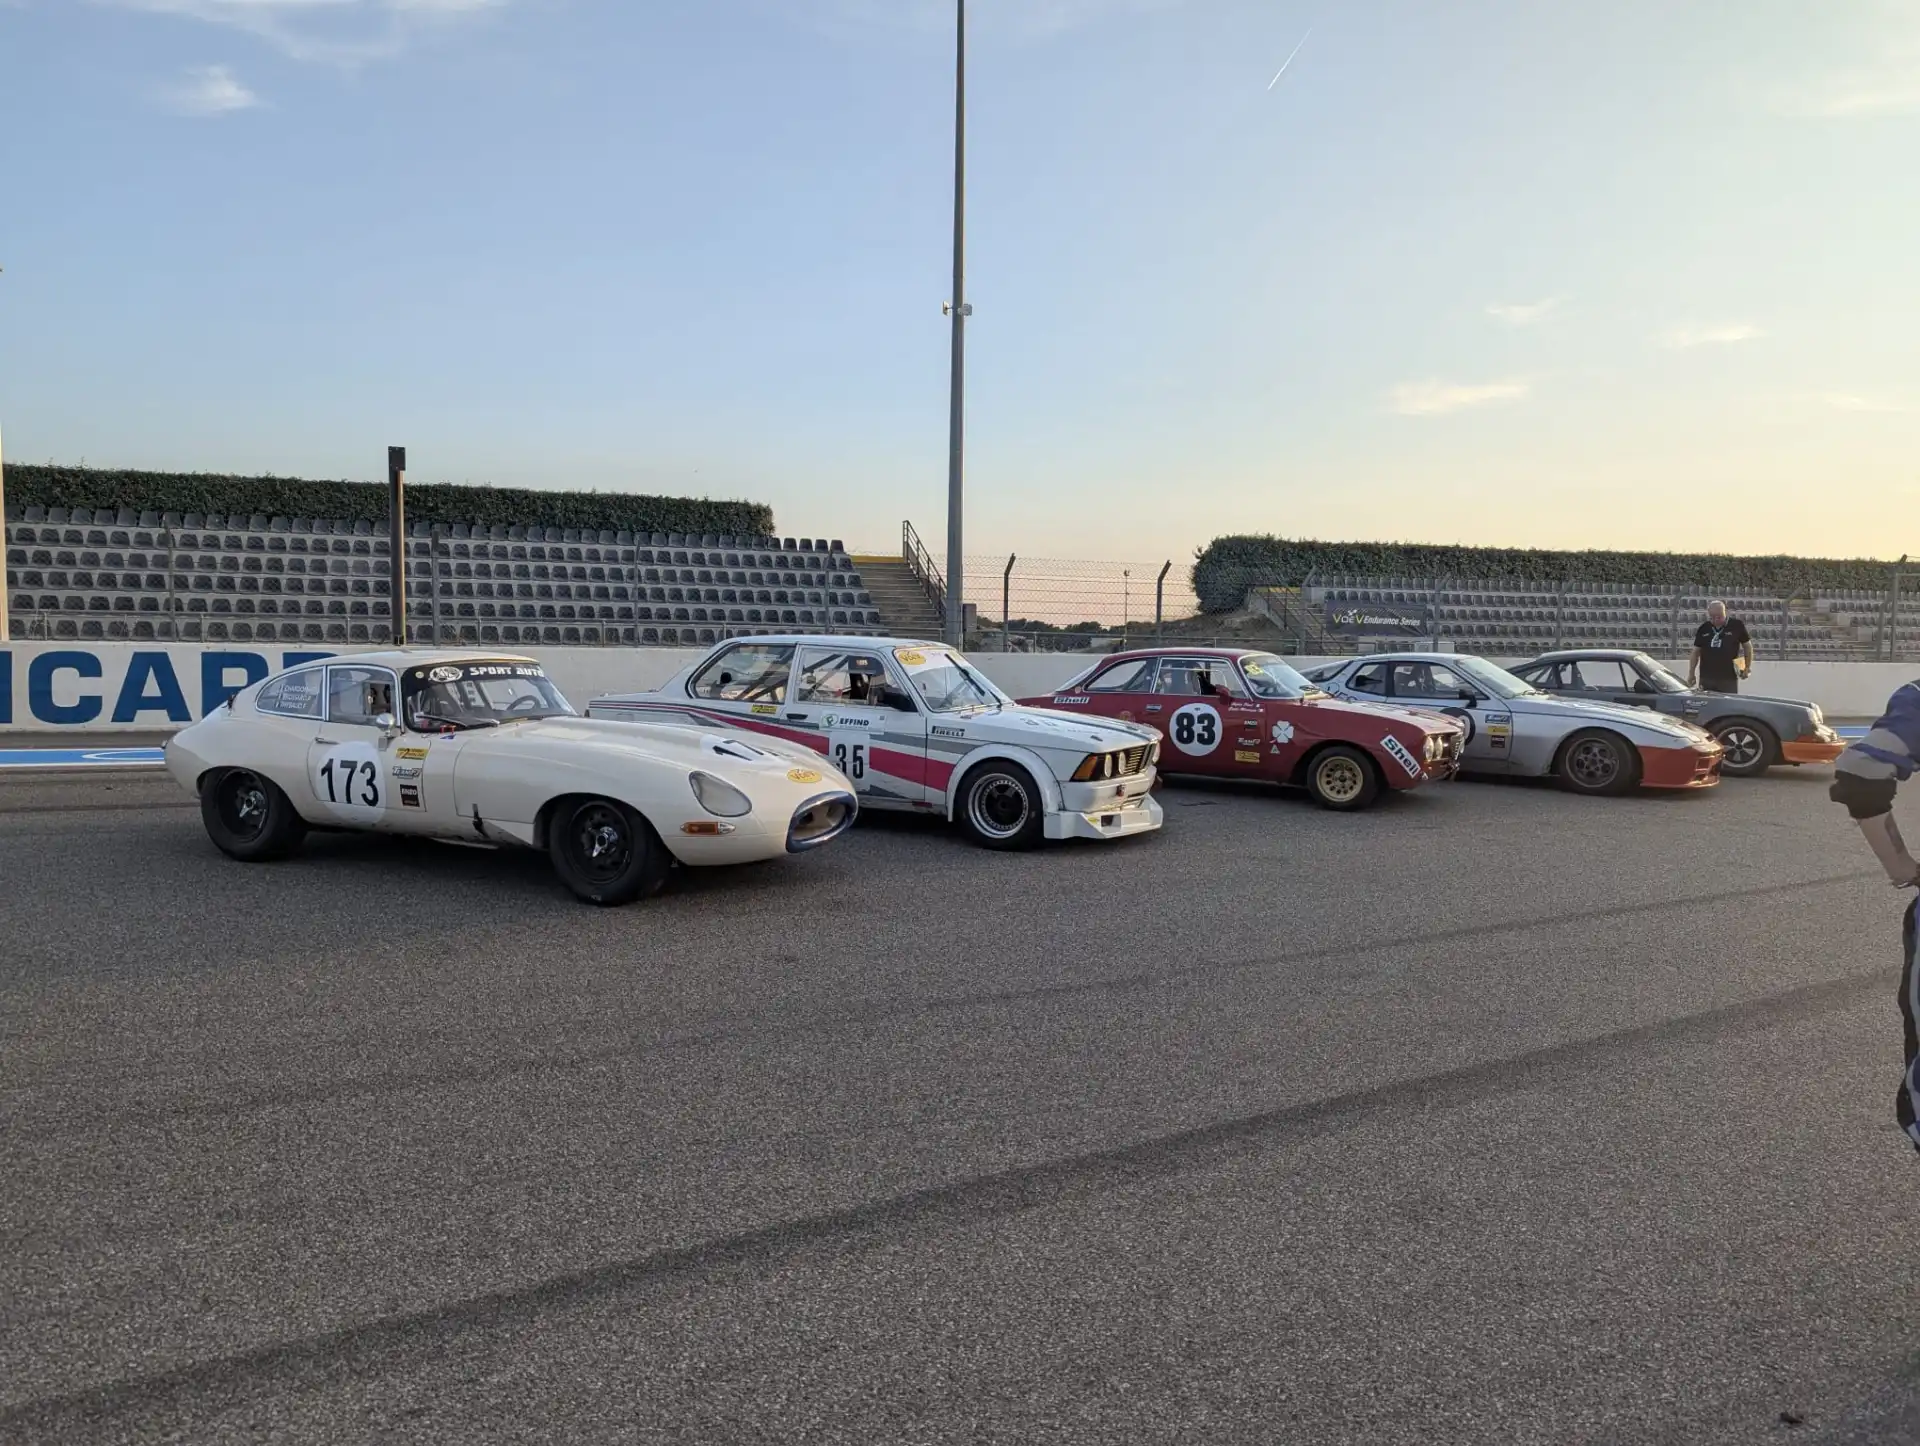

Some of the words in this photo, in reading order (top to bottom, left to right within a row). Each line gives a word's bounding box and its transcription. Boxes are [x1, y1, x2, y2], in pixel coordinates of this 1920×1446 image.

[1363, 615, 1399, 625] Endurance
[1400, 617, 1421, 626] Series
[469, 666, 512, 676] SPORT
[516, 667, 545, 678] AUTO
[839, 717, 870, 727] EFFIND
[931, 726, 966, 738] PIRELLI
[1175, 712, 1216, 746] 83
[1383, 738, 1420, 776] Shell
[321, 758, 379, 807] 173
